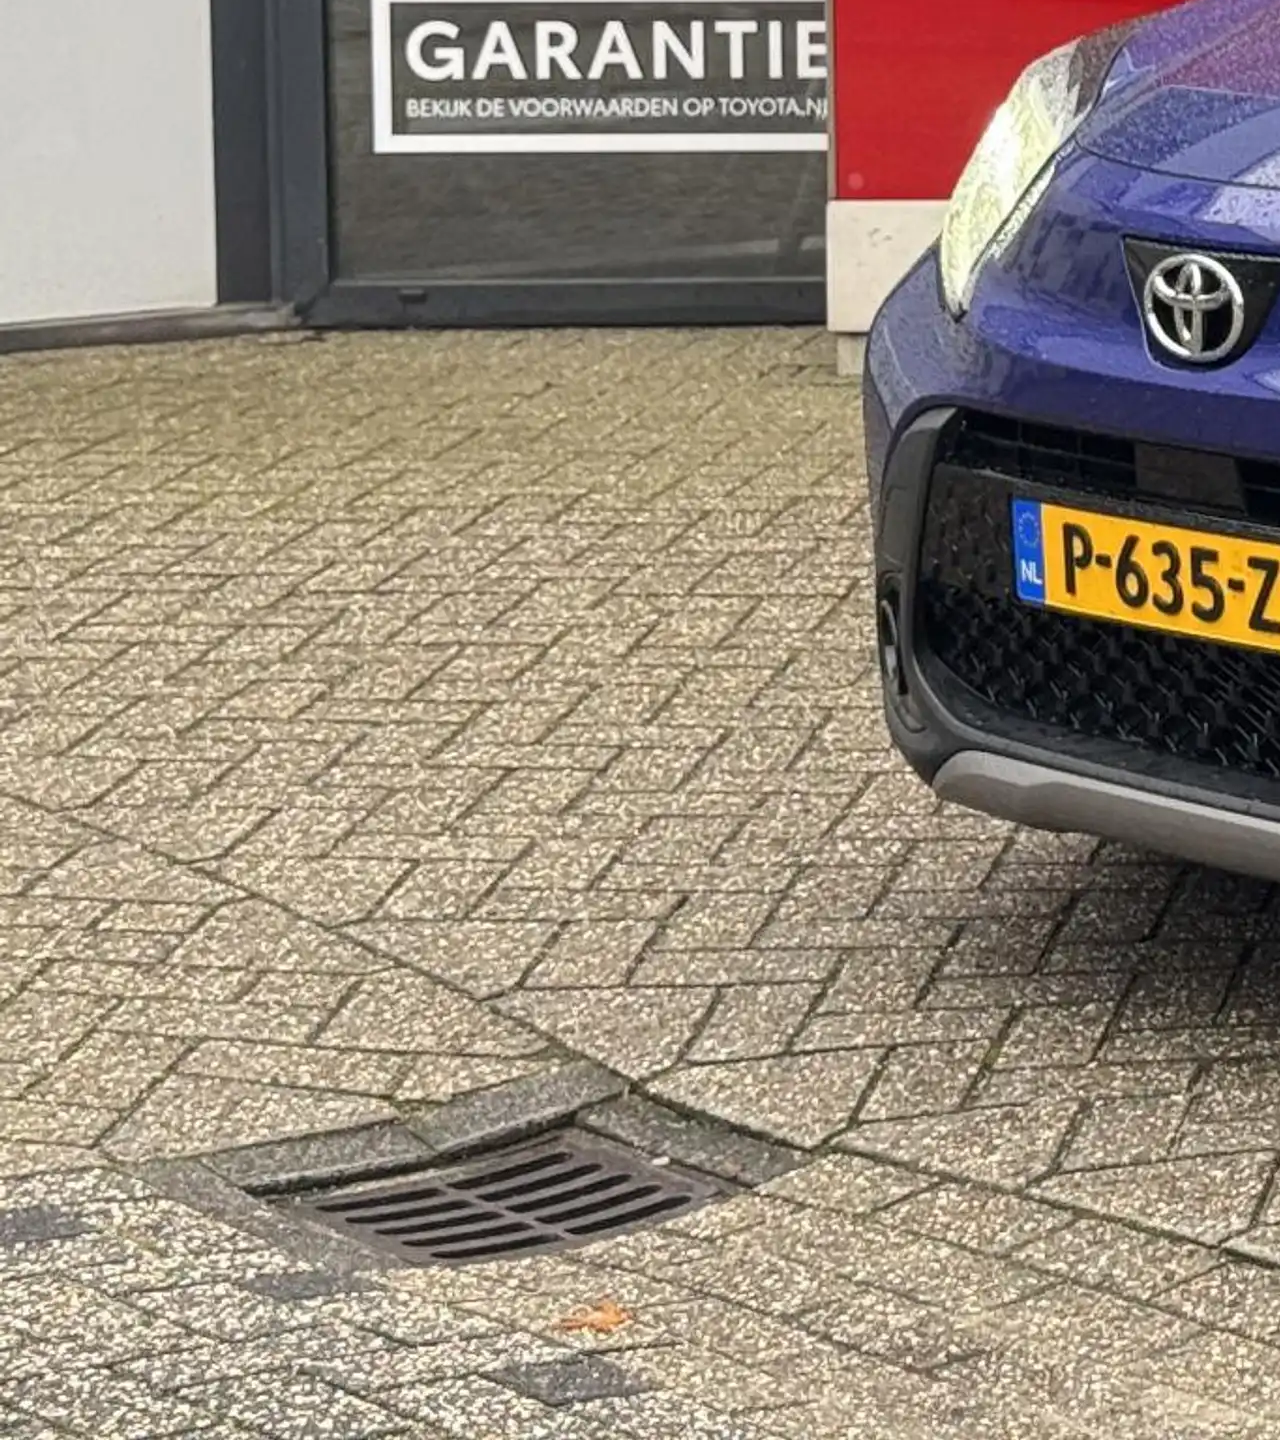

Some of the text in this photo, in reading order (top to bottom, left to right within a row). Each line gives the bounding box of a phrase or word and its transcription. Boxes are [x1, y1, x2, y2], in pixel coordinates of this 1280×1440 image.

[405, 21, 828, 80] GARANTIE
[406, 99, 472, 118] BEKIJK
[477, 99, 504, 117] DE
[510, 98, 678, 118] VOORWAARDEN
[684, 98, 716, 117] OP
[1020, 559, 1042, 585] NL
